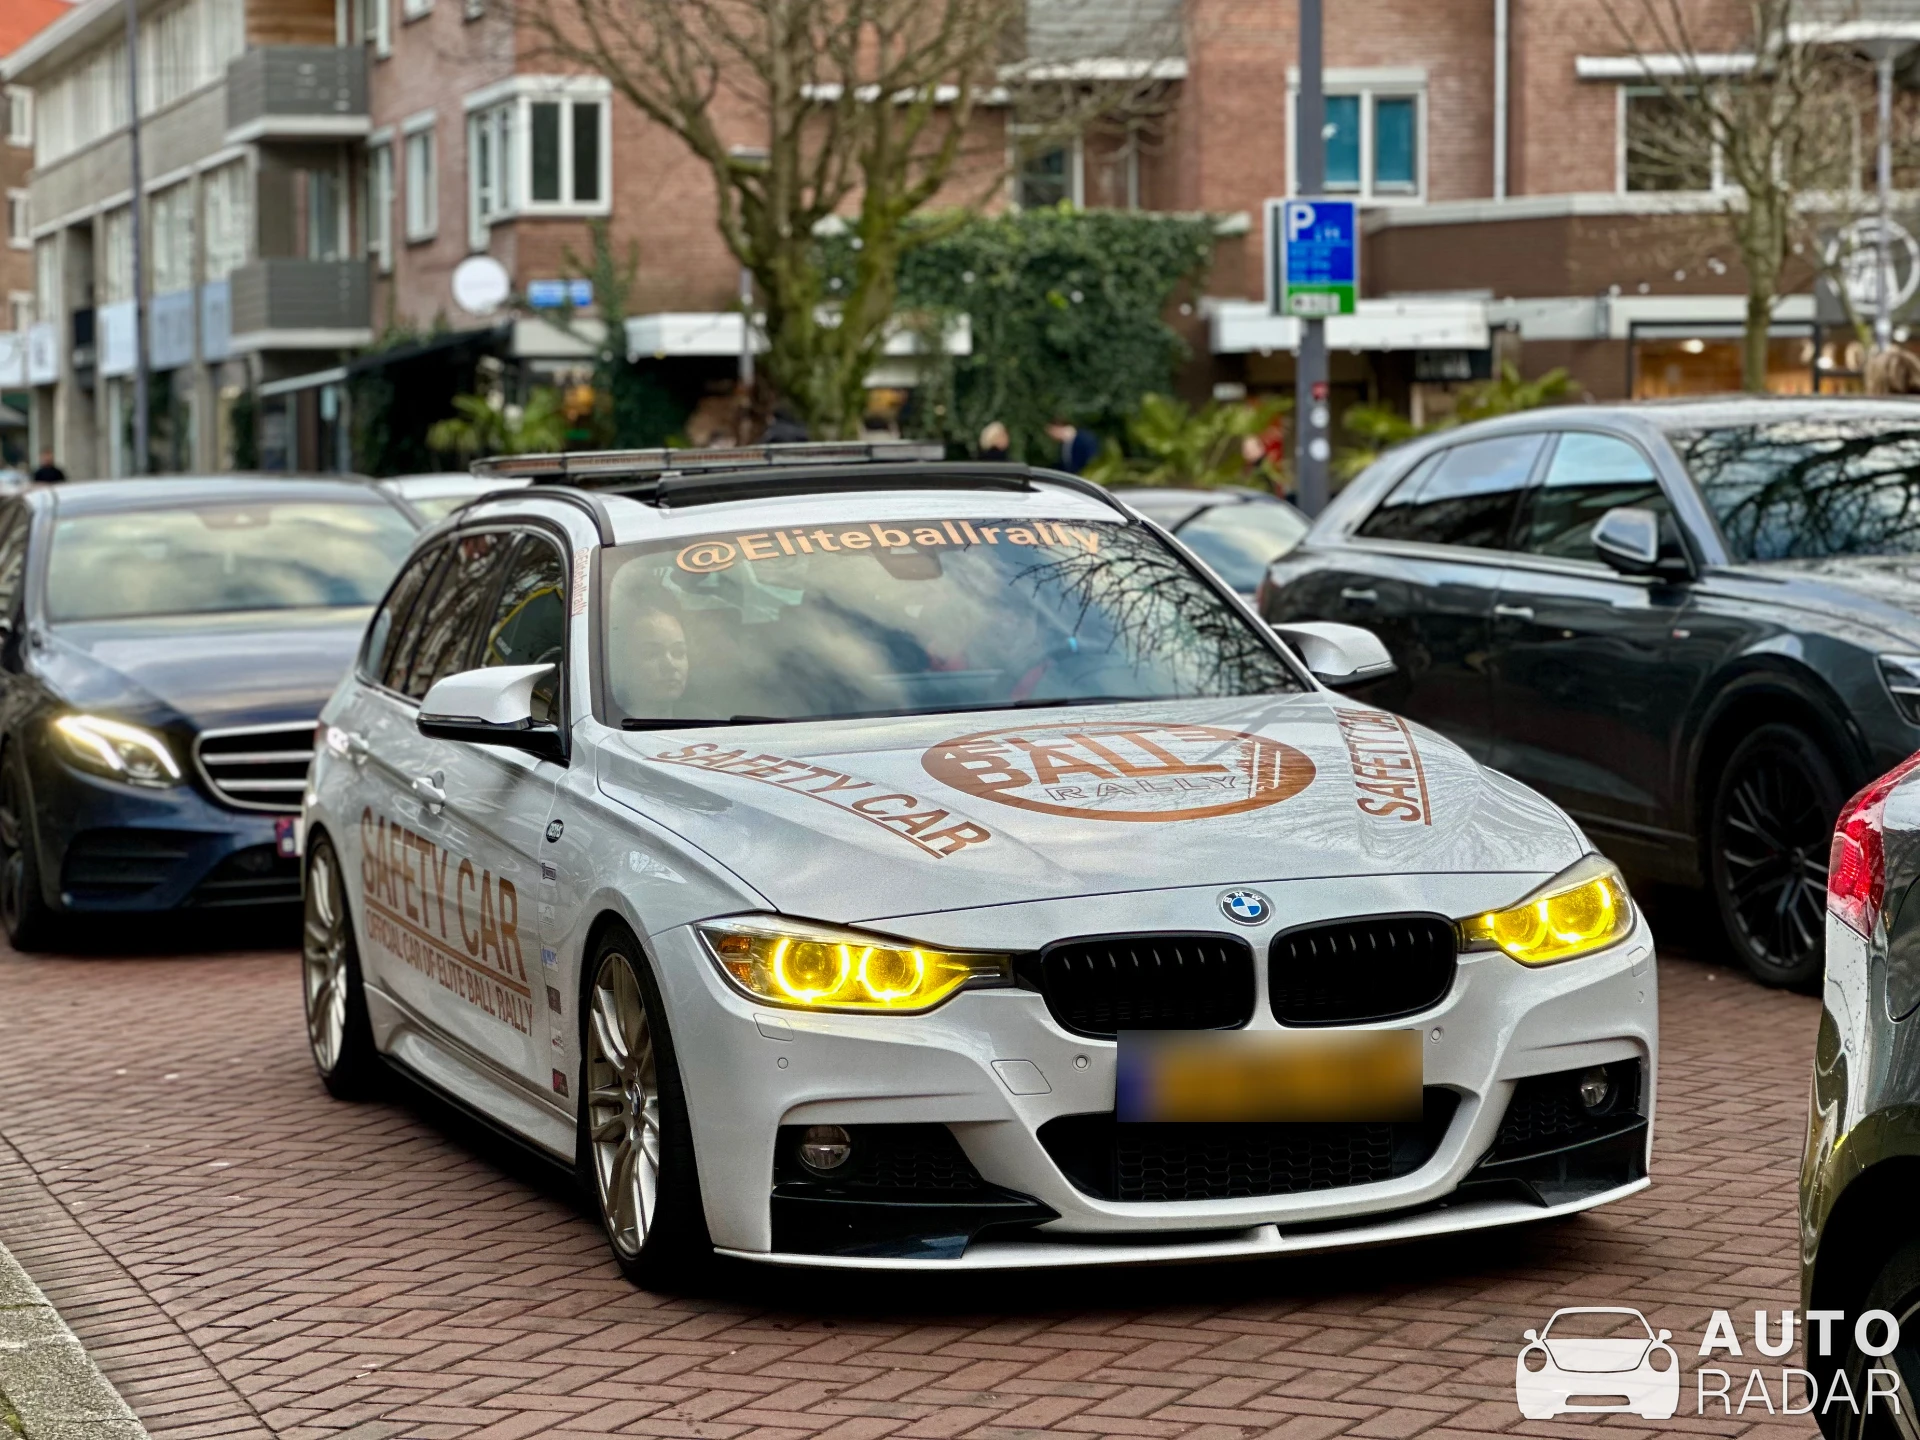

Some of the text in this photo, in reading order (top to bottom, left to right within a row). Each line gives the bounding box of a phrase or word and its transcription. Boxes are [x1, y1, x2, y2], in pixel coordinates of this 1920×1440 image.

[1287, 203, 1316, 242] P
[676, 520, 1099, 573] @Eliteballrally
[657, 743, 991, 856] SAFETY CAR
[1045, 775, 1238, 801] RALLY
[1344, 731, 1421, 822] SAFETY
[361, 806, 527, 983] SAFETY CAR
[366, 908, 404, 959] OFFICIAL
[402, 932, 423, 972] CAR
[422, 943, 435, 980] OF
[437, 952, 465, 999] ELITE
[466, 971, 496, 1016] BALL
[496, 986, 533, 1037] RALLY
